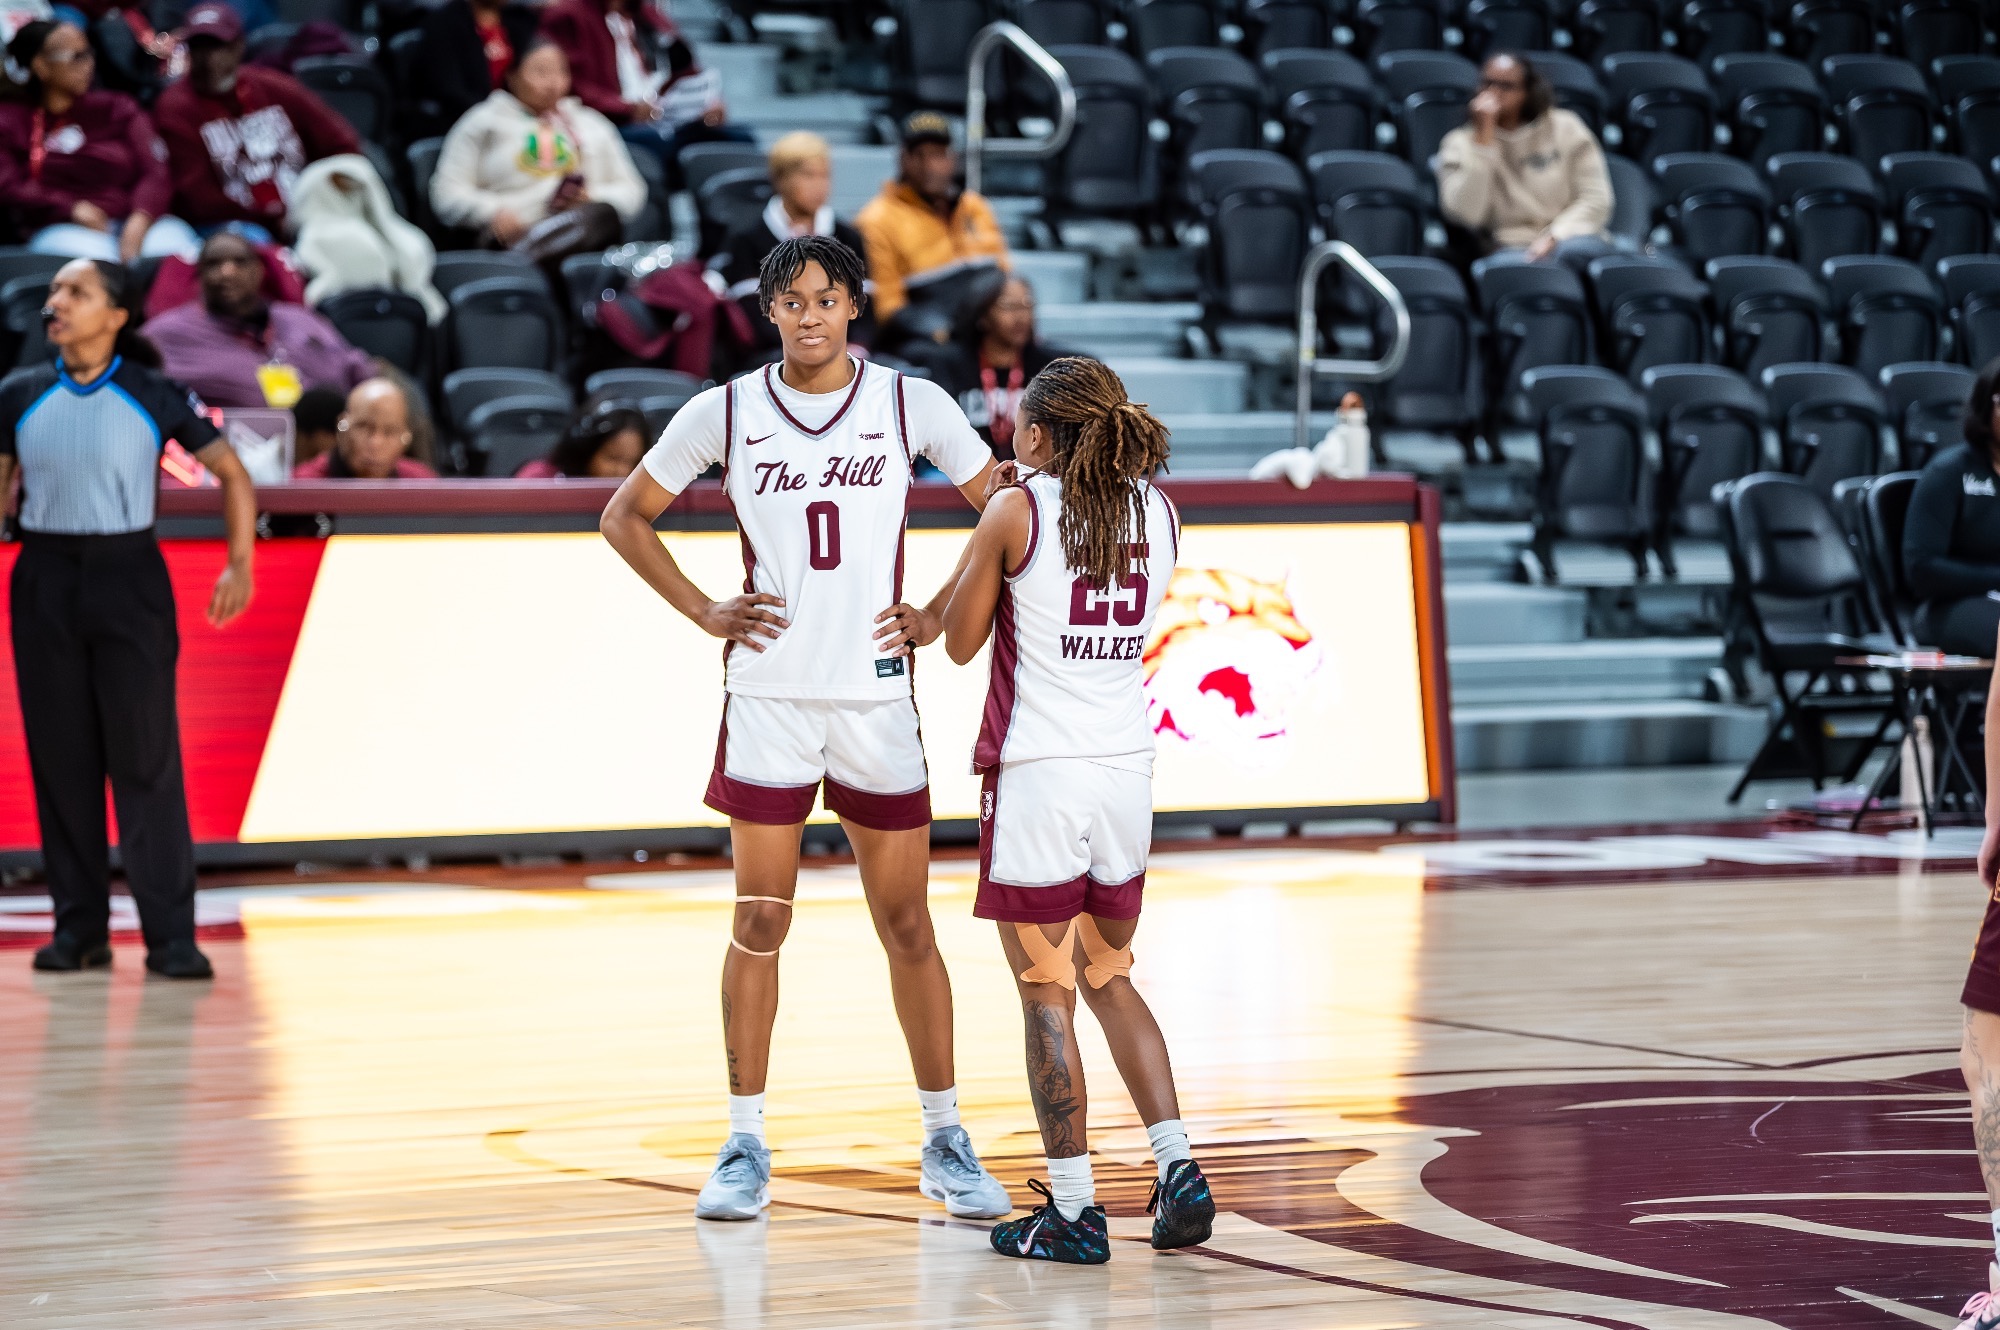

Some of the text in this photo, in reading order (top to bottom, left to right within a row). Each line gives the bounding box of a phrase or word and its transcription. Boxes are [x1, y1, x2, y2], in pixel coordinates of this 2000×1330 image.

[864, 432, 885, 441] SWAC
[754, 454, 887, 496] The Hill
[805, 500, 842, 571] 0
[1068, 542, 1150, 627] 25
[1059, 634, 1145, 661] WALKER
